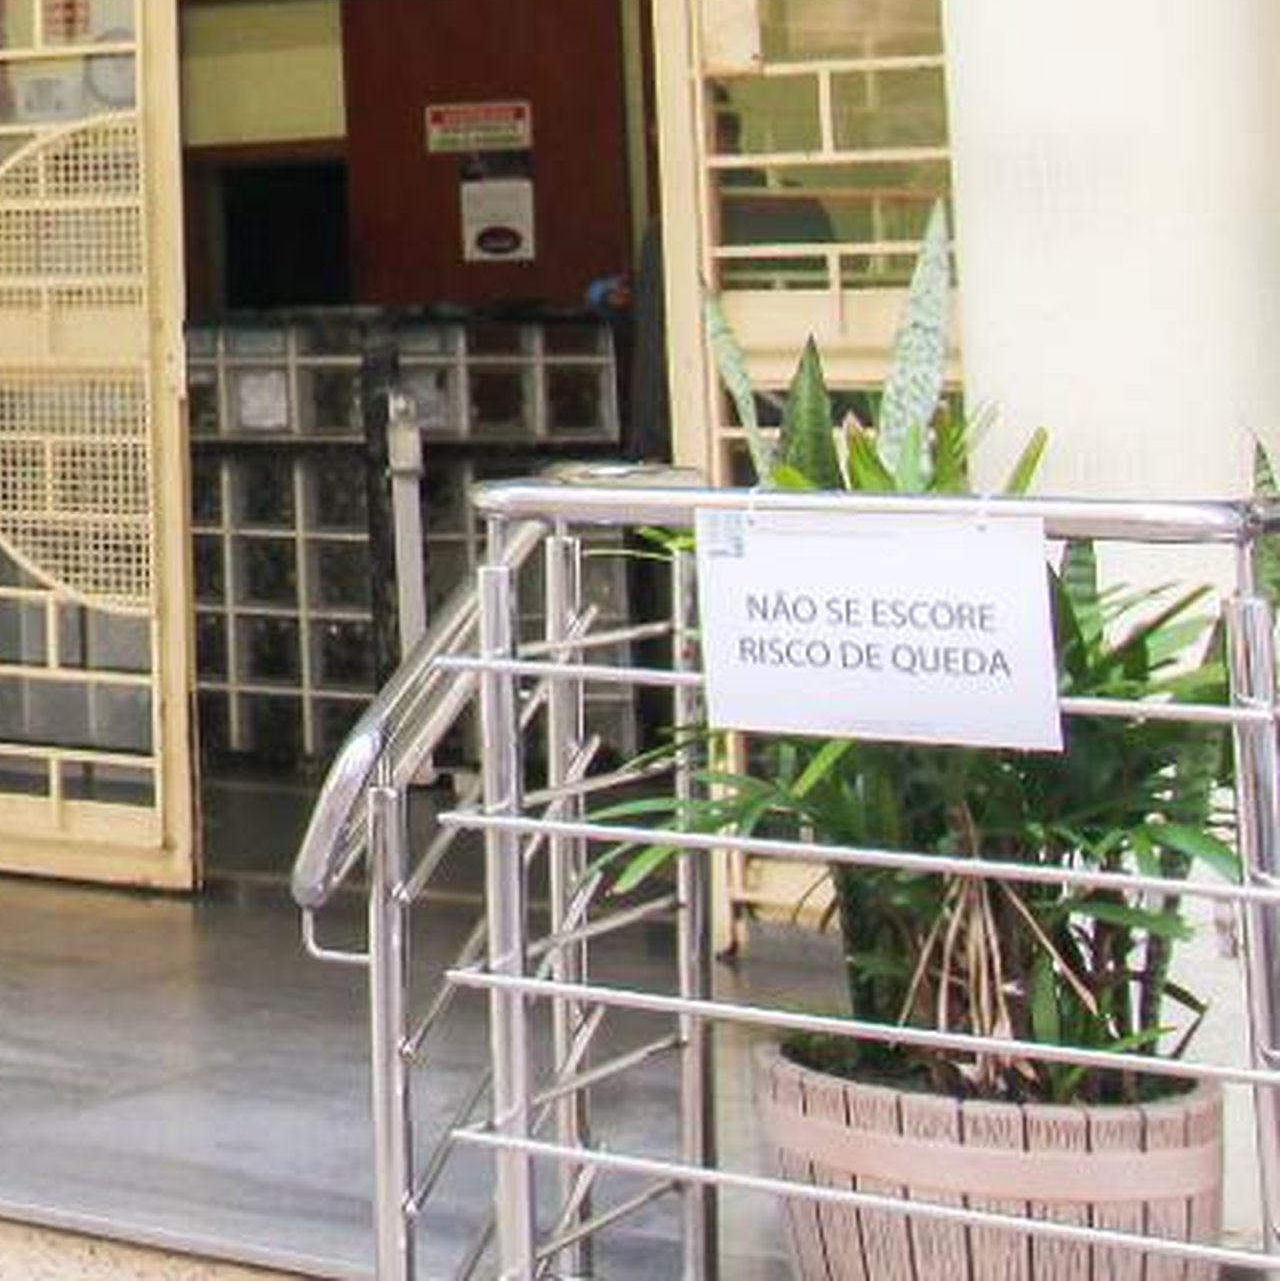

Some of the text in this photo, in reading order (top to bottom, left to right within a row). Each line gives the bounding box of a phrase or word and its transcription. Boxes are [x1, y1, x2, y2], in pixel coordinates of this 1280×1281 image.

[745, 590, 997, 633] NÃO SE ESCORE
[739, 639, 1012, 679] RISCO DE QUEDA
